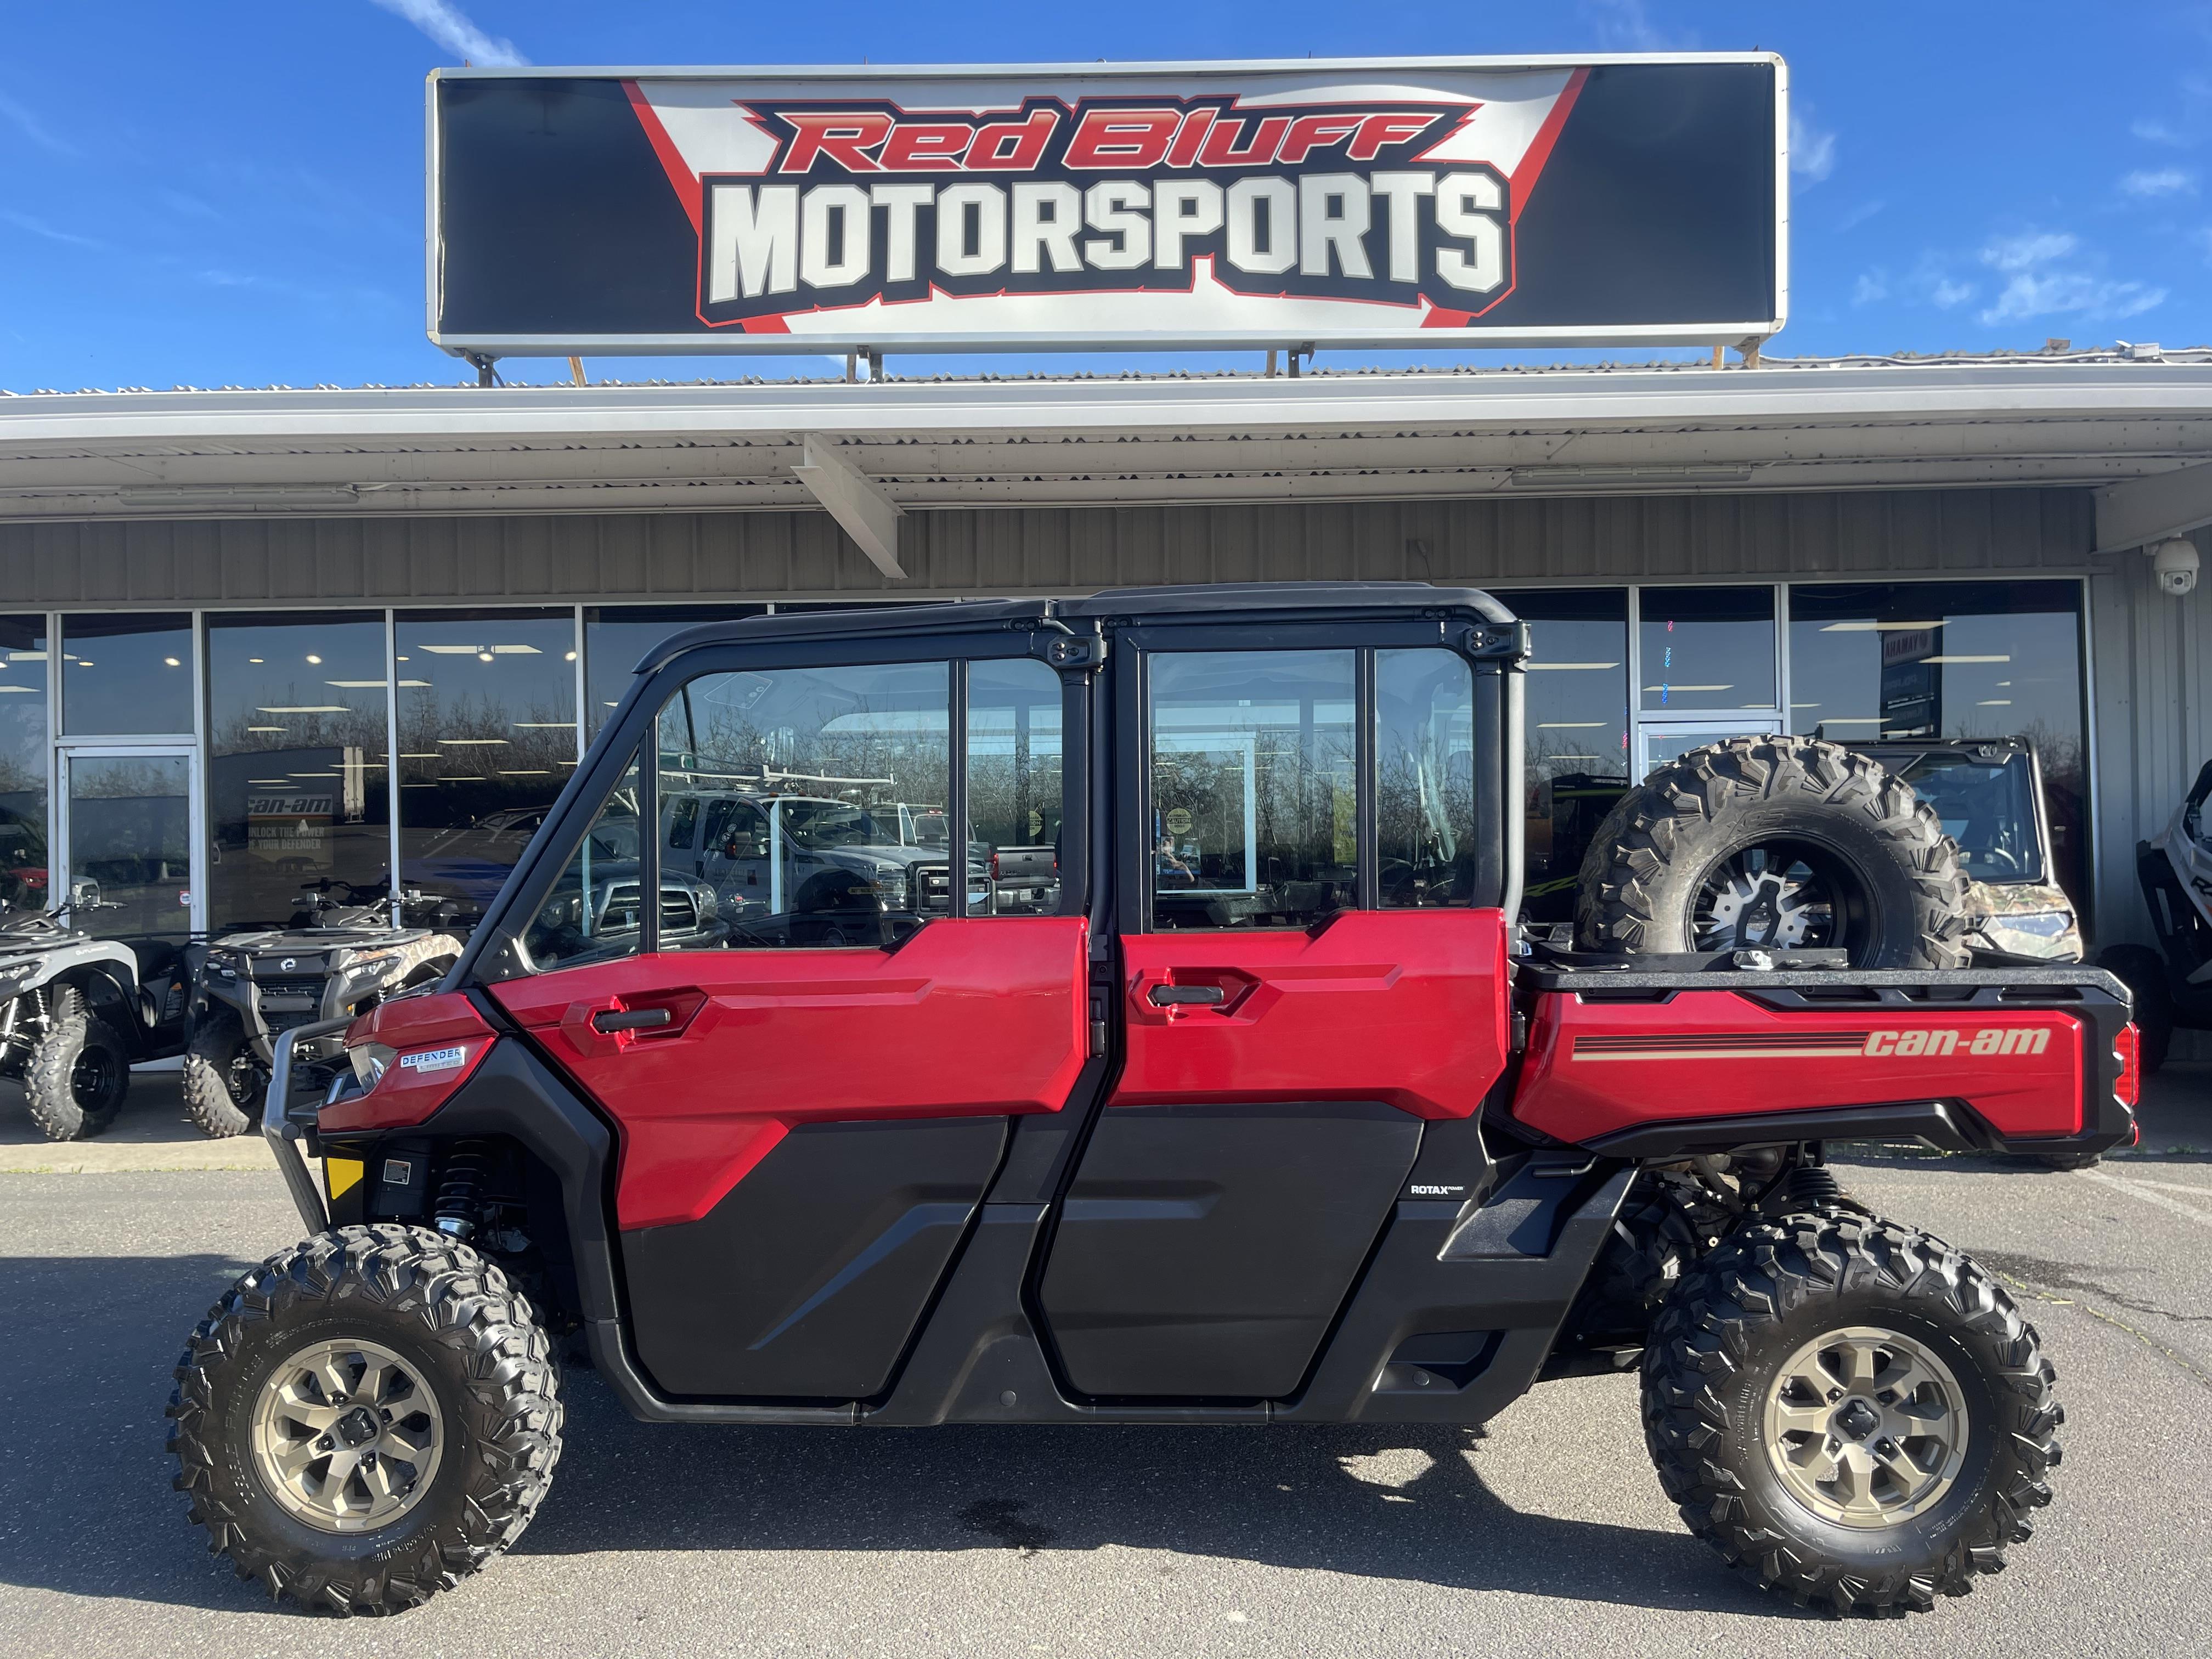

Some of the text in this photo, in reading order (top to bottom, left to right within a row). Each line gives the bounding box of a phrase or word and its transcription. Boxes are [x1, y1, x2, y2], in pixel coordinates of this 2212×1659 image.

[774, 109, 1060, 173] Red
[709, 171, 1504, 303] MOTORSPORTS
[280, 827, 294, 837] THE
[258, 839, 279, 850] YOUR
[281, 839, 321, 850] DEFENDER
[1864, 1028, 2051, 1056] can-am
[403, 1049, 461, 1065] DEFENDER
[1411, 1186, 1448, 1194] ROTAX
